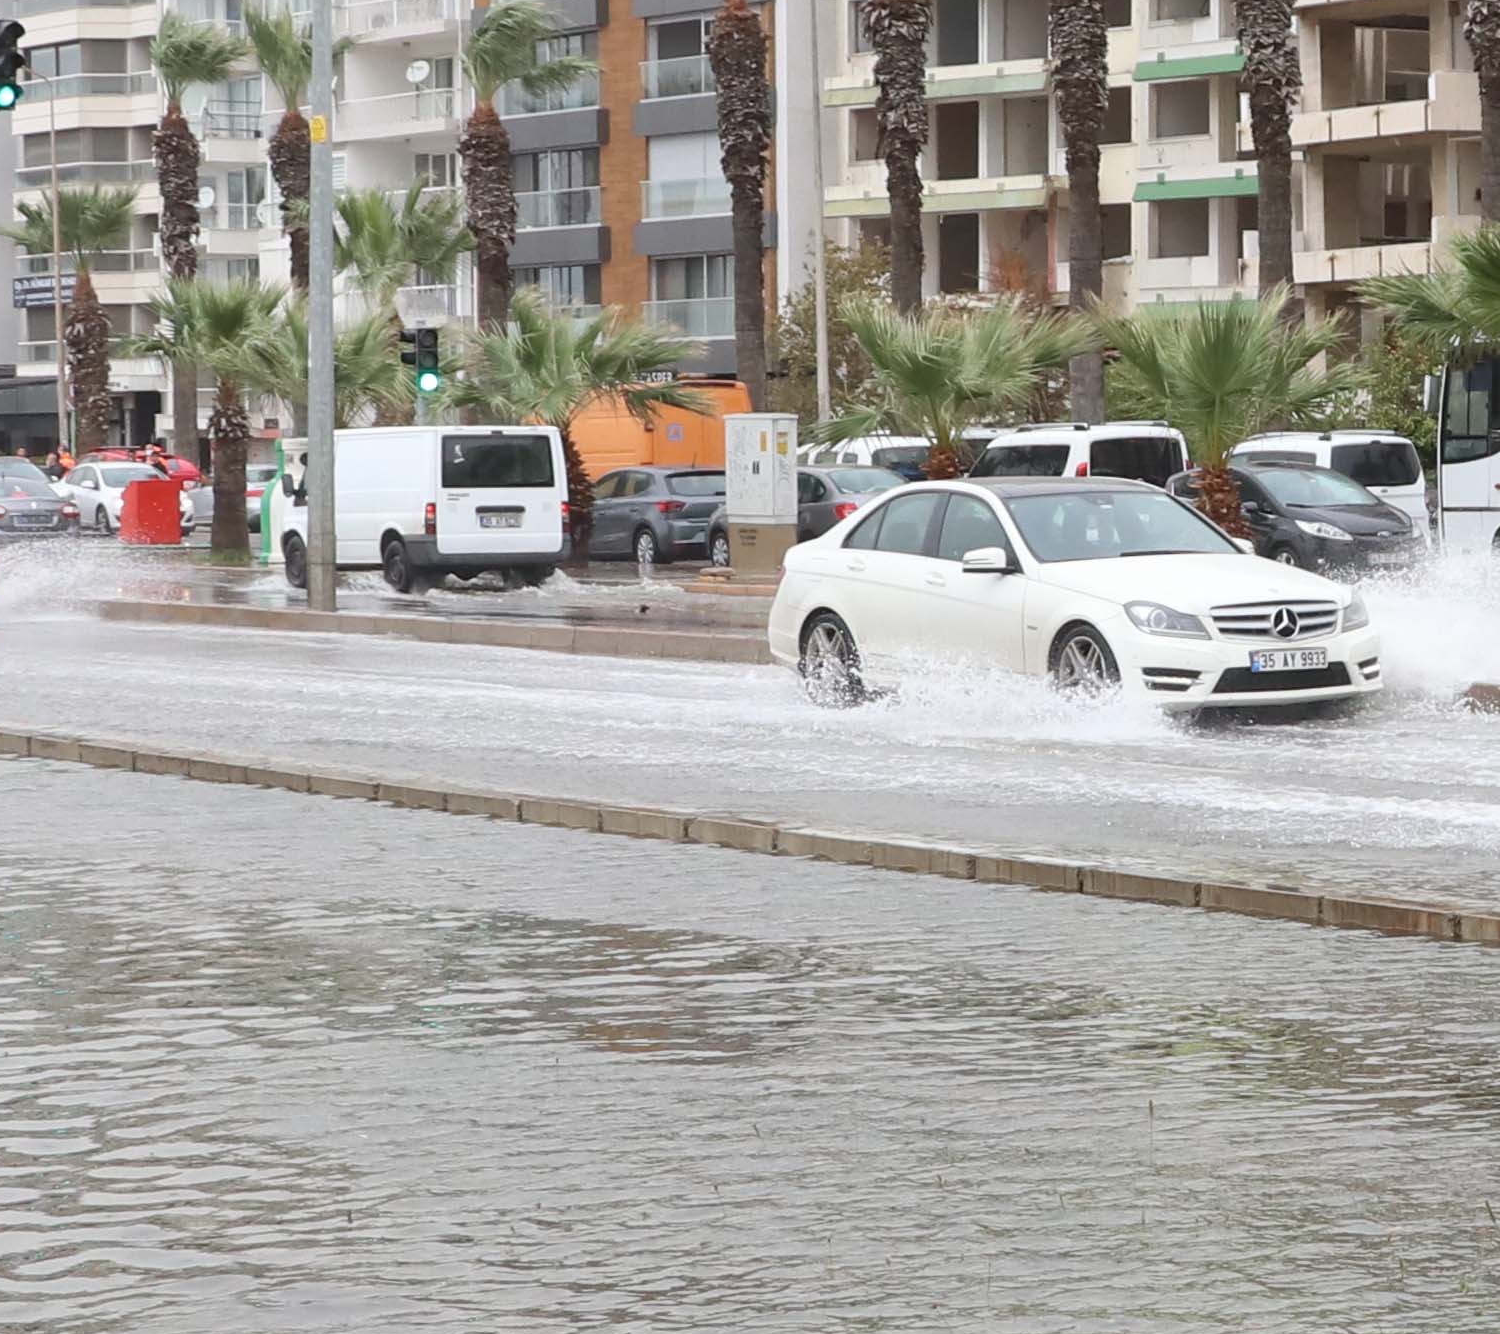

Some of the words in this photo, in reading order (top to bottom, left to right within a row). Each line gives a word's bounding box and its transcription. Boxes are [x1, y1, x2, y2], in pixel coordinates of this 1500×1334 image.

[1261, 653, 1276, 668] 35
[1282, 652, 1297, 668] AY
[1300, 650, 1326, 667] 9933
